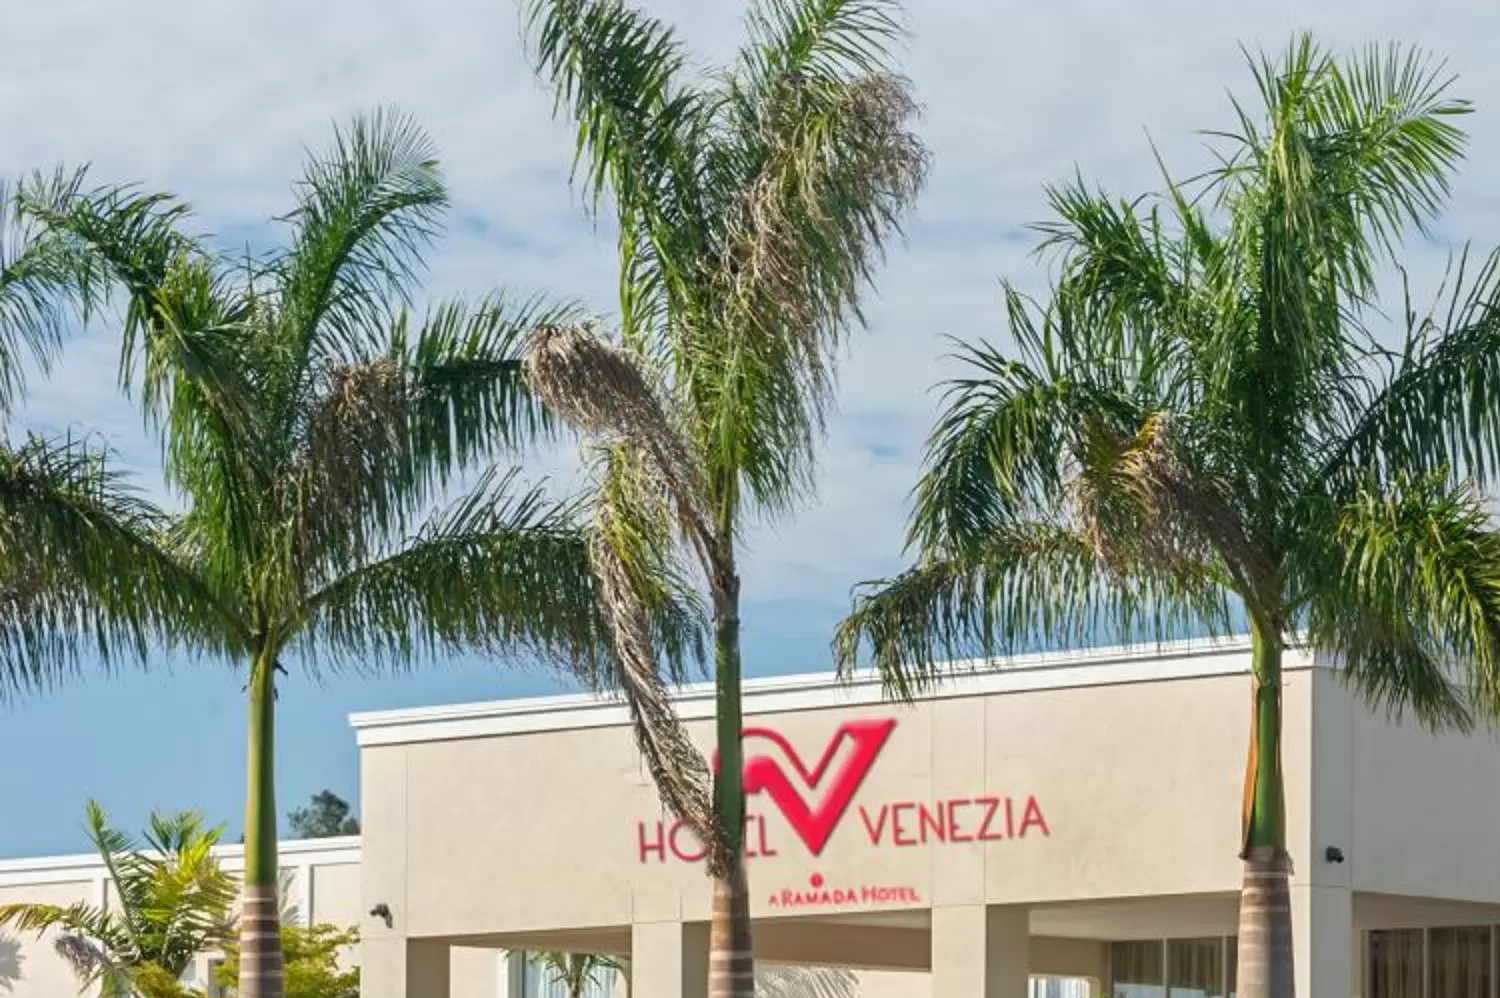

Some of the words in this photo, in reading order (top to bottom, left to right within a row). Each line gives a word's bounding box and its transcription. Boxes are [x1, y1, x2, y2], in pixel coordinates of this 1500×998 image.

[638, 813, 777, 862] HOEL
[859, 796, 1050, 845] VENEZIA
[781, 888, 857, 908] RAMADA
[861, 885, 921, 904] HOTEL
